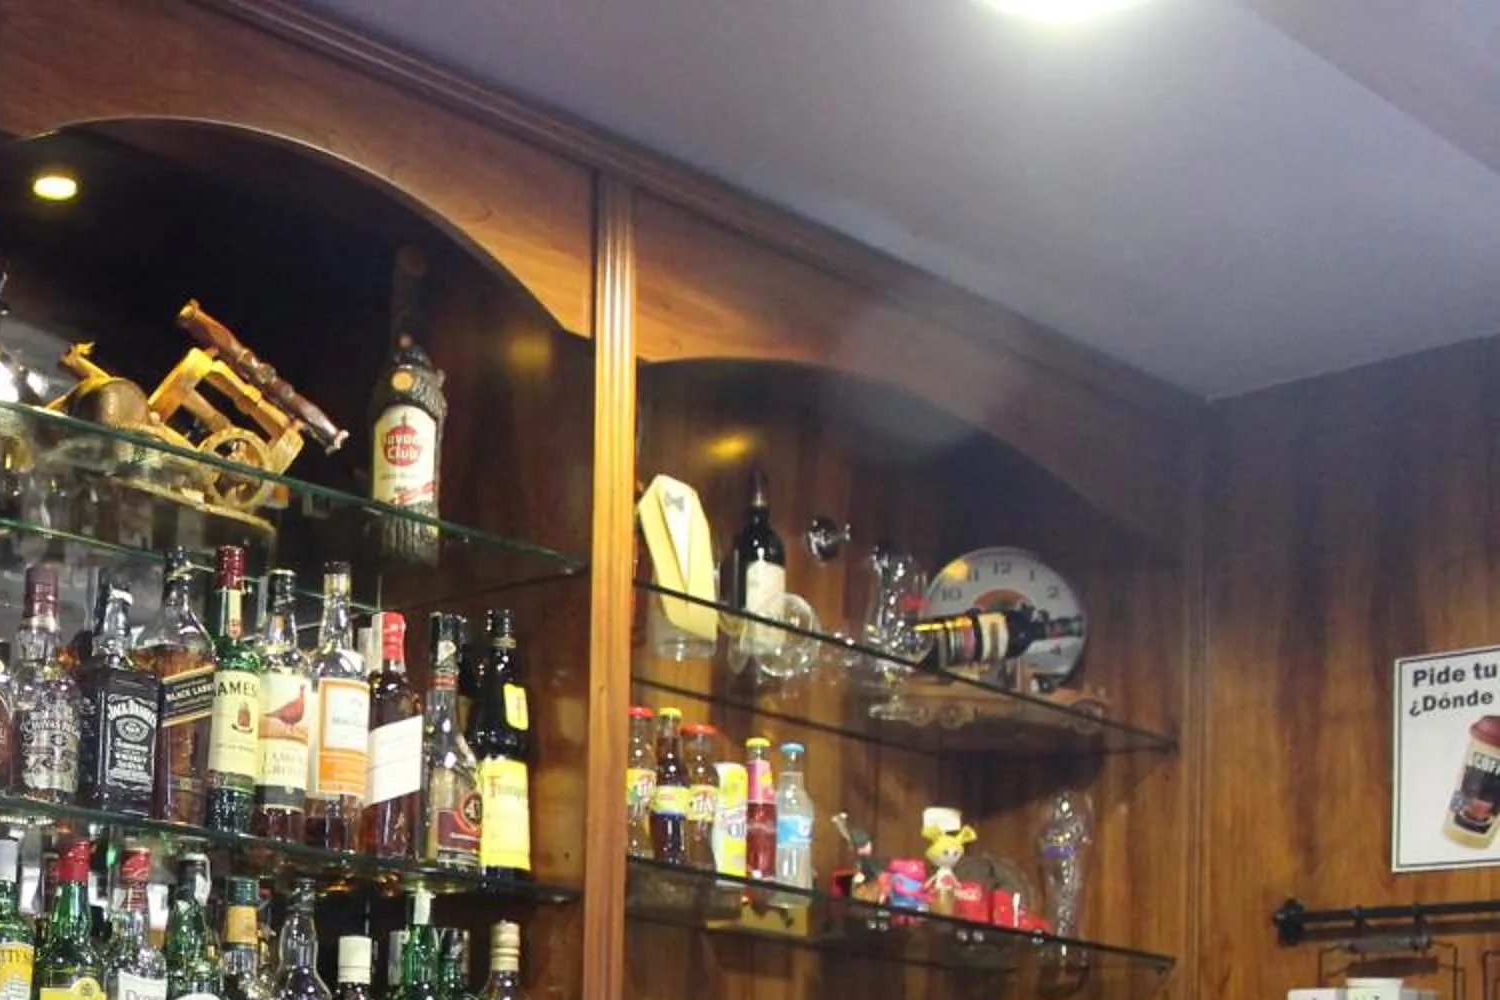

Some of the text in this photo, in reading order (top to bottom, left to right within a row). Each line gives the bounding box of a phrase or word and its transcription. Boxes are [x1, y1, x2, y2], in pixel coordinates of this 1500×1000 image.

[1411, 662, 1497, 688] Pide tu
[217, 680, 257, 698] AMES
[1408, 690, 1493, 717] ¿Dónde
